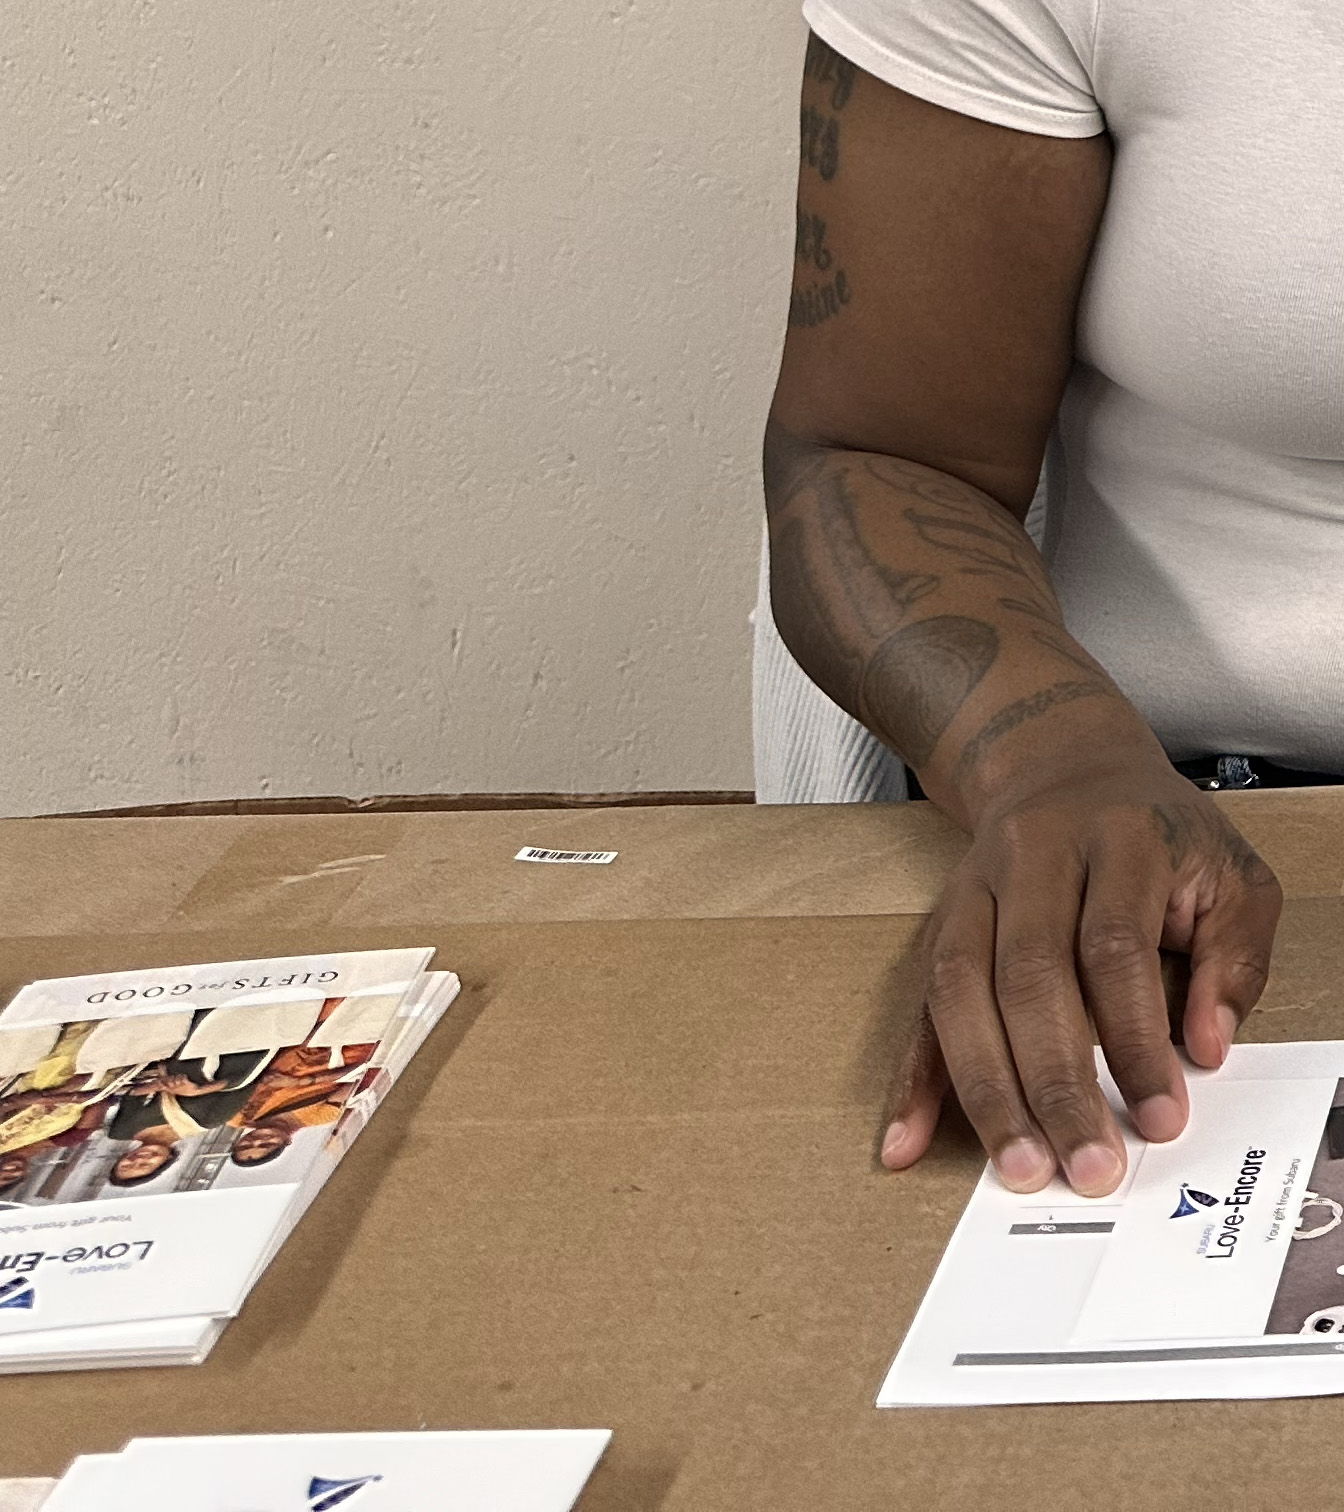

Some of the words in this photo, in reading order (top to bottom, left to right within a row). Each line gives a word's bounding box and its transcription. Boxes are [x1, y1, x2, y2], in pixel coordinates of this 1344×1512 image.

[231, 968, 339, 992] GIFTS
[86, 981, 193, 1005] GOOD
[1282, 1157, 1301, 1186] Subaru
[1204, 1148, 1267, 1259] Love-Encore
[1276, 1186, 1292, 1206] from
[1272, 1209, 1286, 1221] gift
[1264, 1222, 1281, 1243] Your
